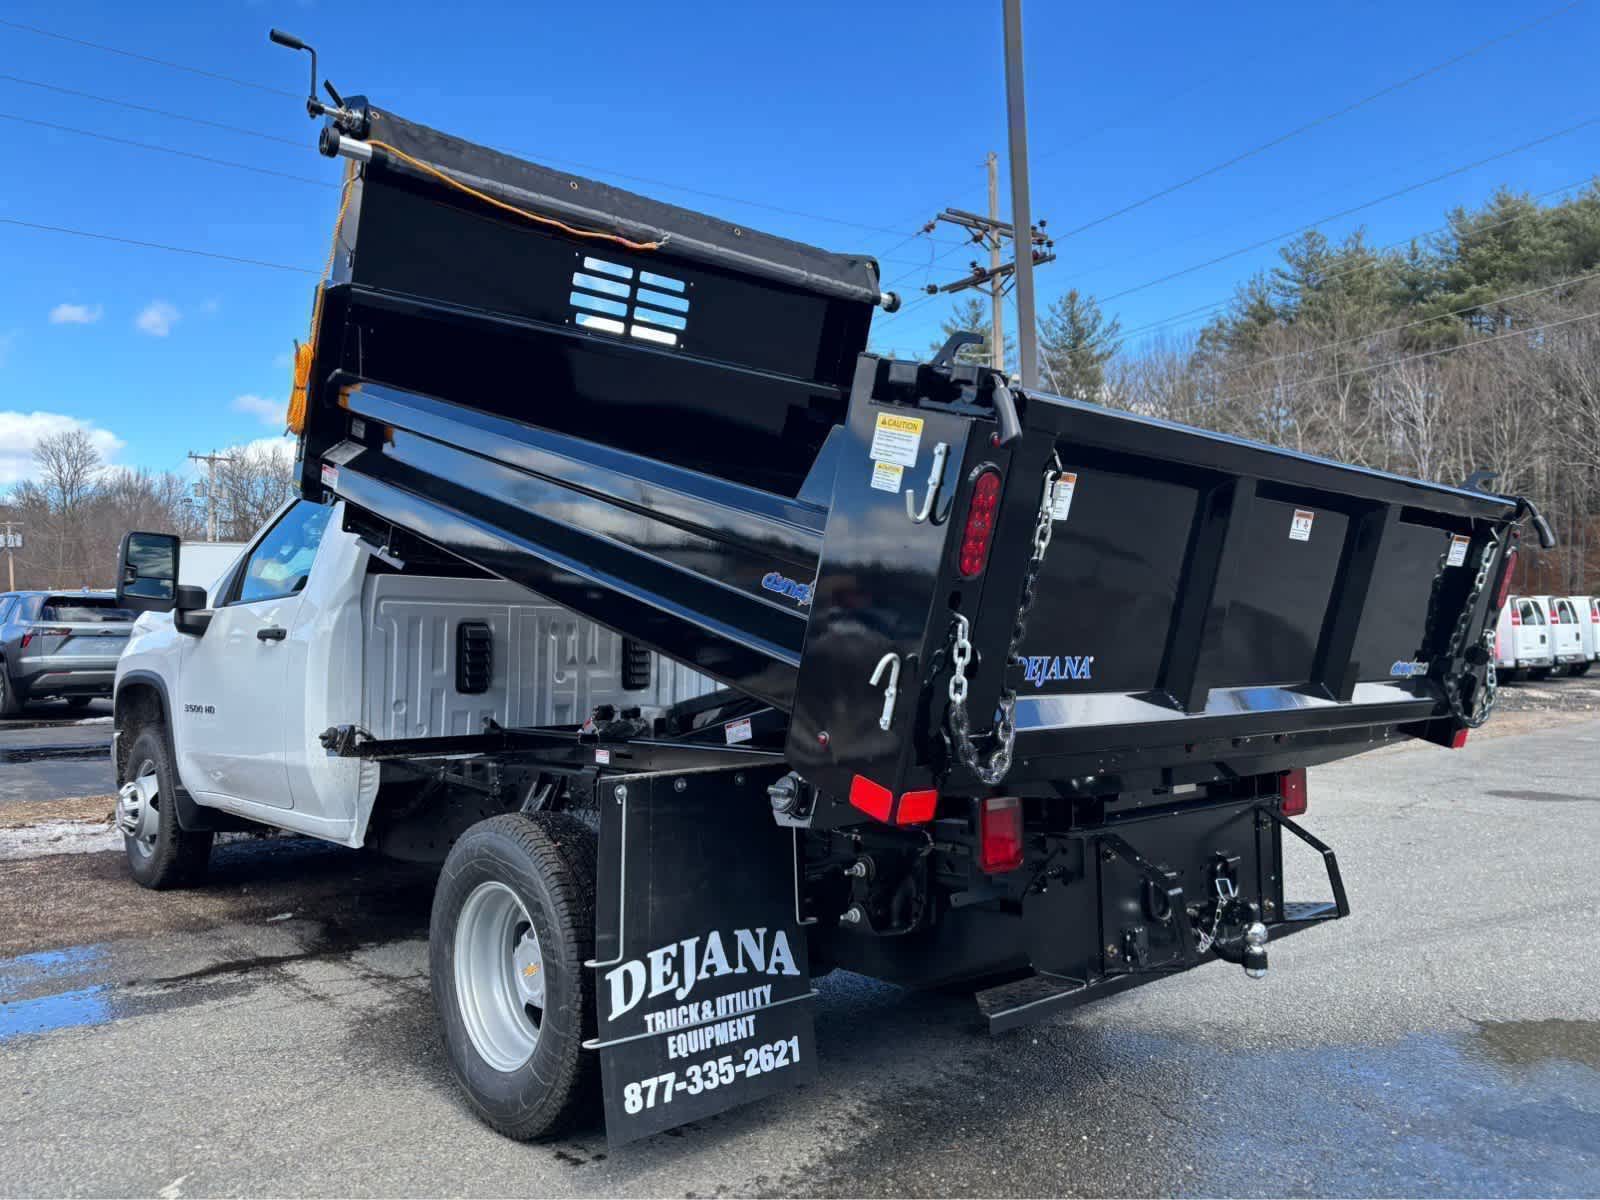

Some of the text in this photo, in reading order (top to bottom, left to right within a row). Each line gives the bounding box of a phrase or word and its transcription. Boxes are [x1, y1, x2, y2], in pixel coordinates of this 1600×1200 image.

[887, 418, 918, 431] CAUTION
[184, 703, 216, 714] 3500 HD
[604, 927, 801, 1022] DEJANA
[667, 1014, 757, 1060] EQUIPMENT
[623, 1035, 801, 1115] 877-335-2621
